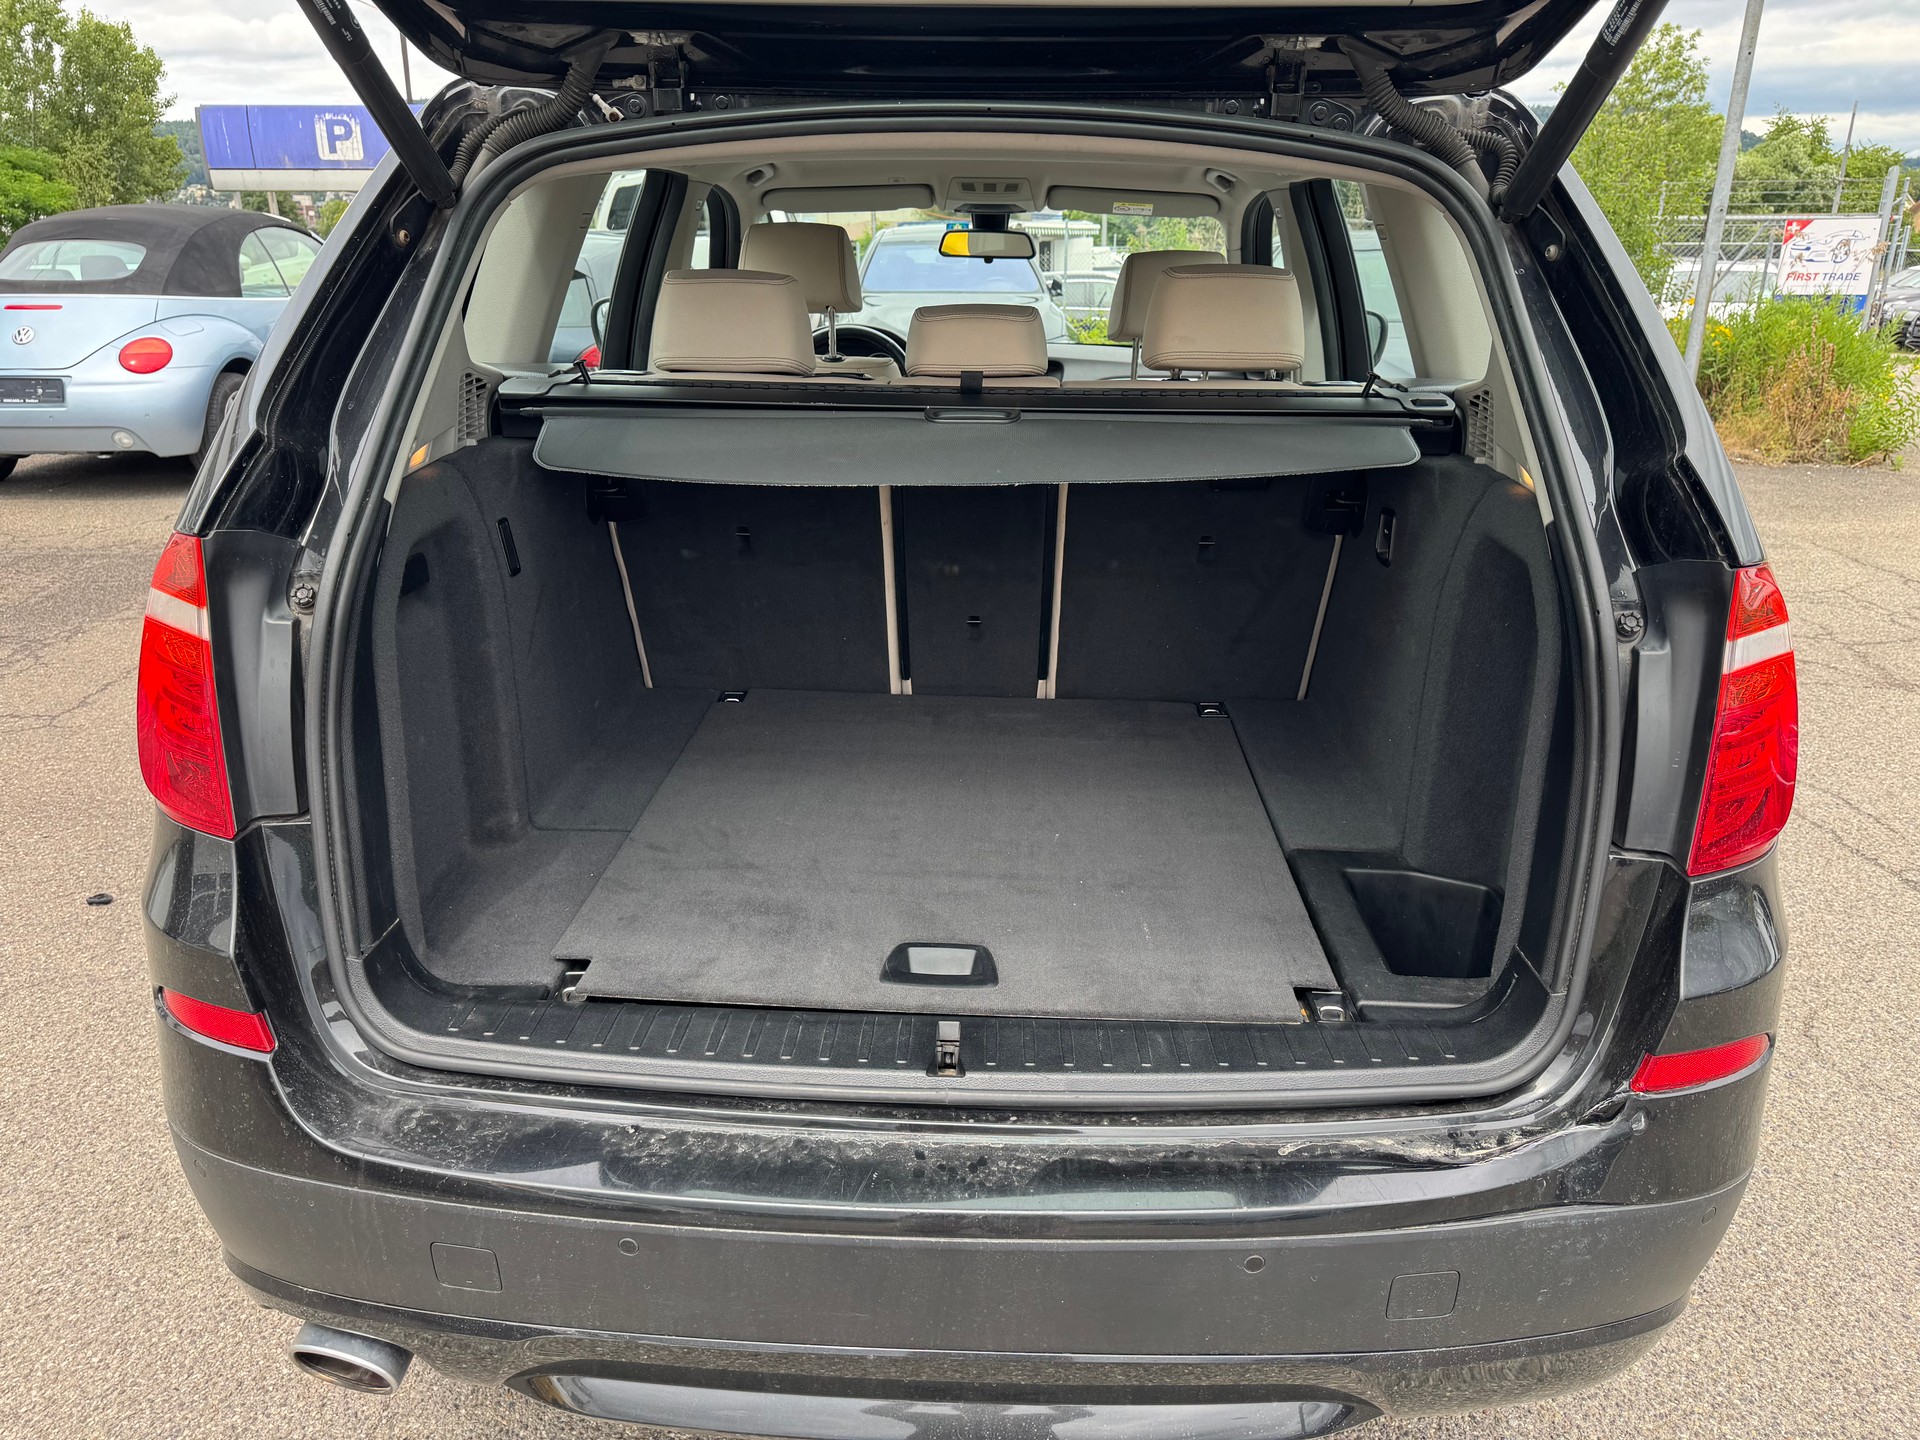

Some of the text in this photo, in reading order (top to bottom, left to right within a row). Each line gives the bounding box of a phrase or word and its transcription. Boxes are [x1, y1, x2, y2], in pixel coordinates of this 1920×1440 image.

[325, 119, 353, 154] P
[1786, 272, 1861, 281] FIRST TRADE
[12, 326, 35, 345] VW
